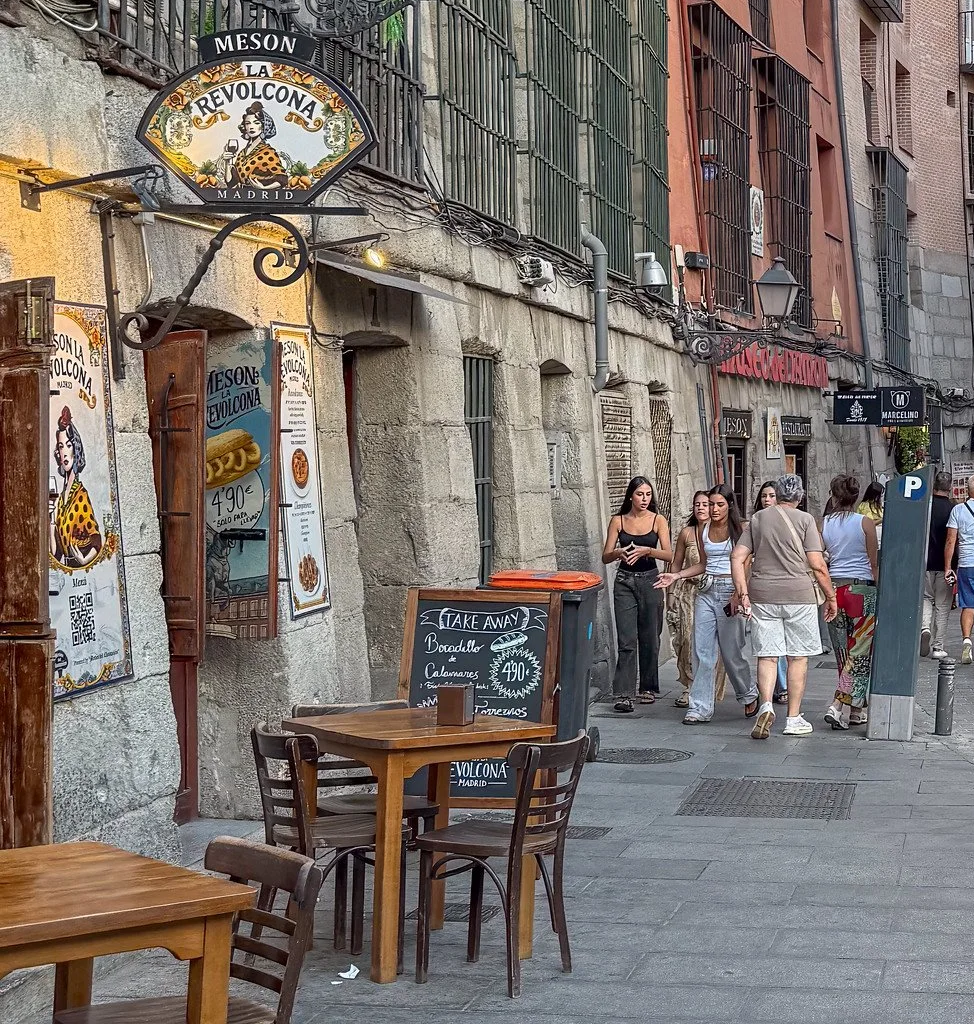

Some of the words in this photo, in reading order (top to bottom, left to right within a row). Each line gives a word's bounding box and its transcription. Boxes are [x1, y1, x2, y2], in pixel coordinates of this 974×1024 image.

[214, 32, 297, 55] MESON
[245, 64, 272, 77] LA
[193, 81, 317, 120] REVOLCONA
[217, 190, 294, 200] MADRID
[222, 390, 231, 399] LA
[206, 387, 262, 424] EVOLCONA
[881, 411, 919, 419] MARCELINO
[904, 476, 922, 498] P
[446, 613, 479, 630] TAKE
[483, 612, 519, 630] AWAY
[425, 632, 485, 654] Bocadillo
[425, 662, 479, 680] Calamares
[450, 762, 508, 778] EVOLCONA
[458, 779, 487, 787] MADRID
